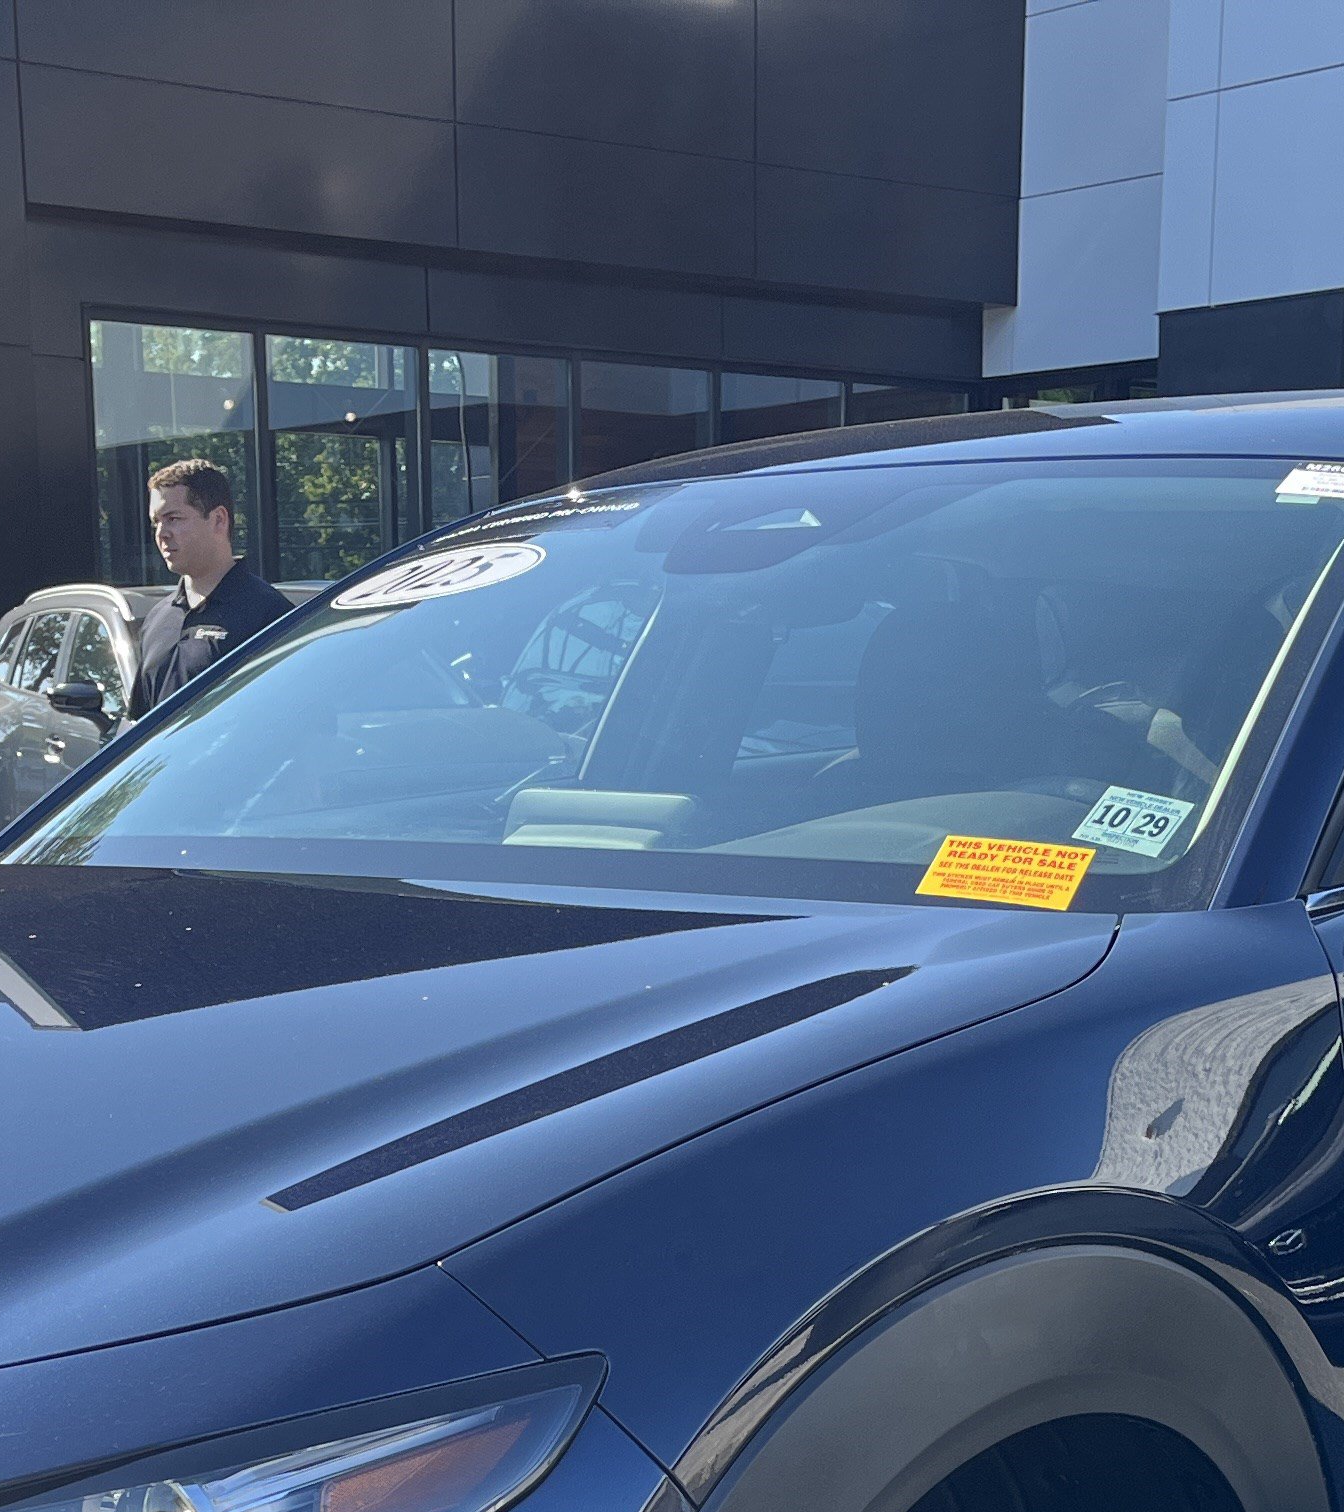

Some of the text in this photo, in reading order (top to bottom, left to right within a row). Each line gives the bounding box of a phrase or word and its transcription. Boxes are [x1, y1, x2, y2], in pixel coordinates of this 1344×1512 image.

[1092, 804, 1170, 837] 10 29
[947, 850, 1077, 870] READY FOR SALE
[948, 840, 1089, 861] THIS VEHICLE NOT
[971, 864, 1001, 872] DEALER
[1001, 866, 1017, 874] FOR
[1019, 868, 1053, 879] RELEASE
[1054, 873, 1075, 882] DATE
